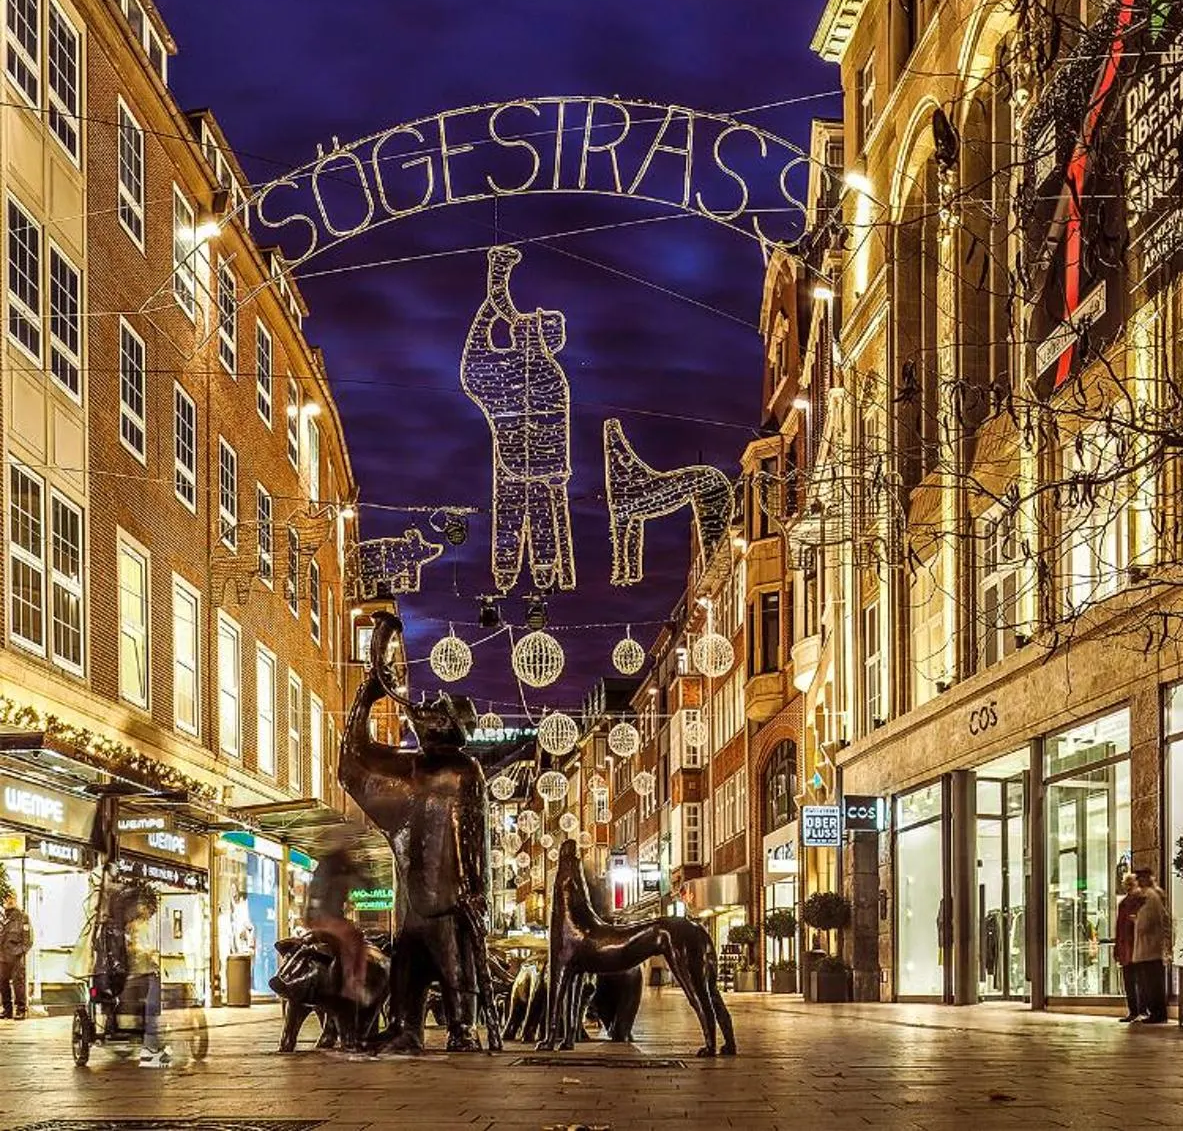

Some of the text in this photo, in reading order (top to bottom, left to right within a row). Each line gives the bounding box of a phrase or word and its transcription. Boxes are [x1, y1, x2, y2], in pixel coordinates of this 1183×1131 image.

[969, 701, 997, 736] COS
[4, 786, 65, 822] WEMPE
[847, 807, 876, 819] COS
